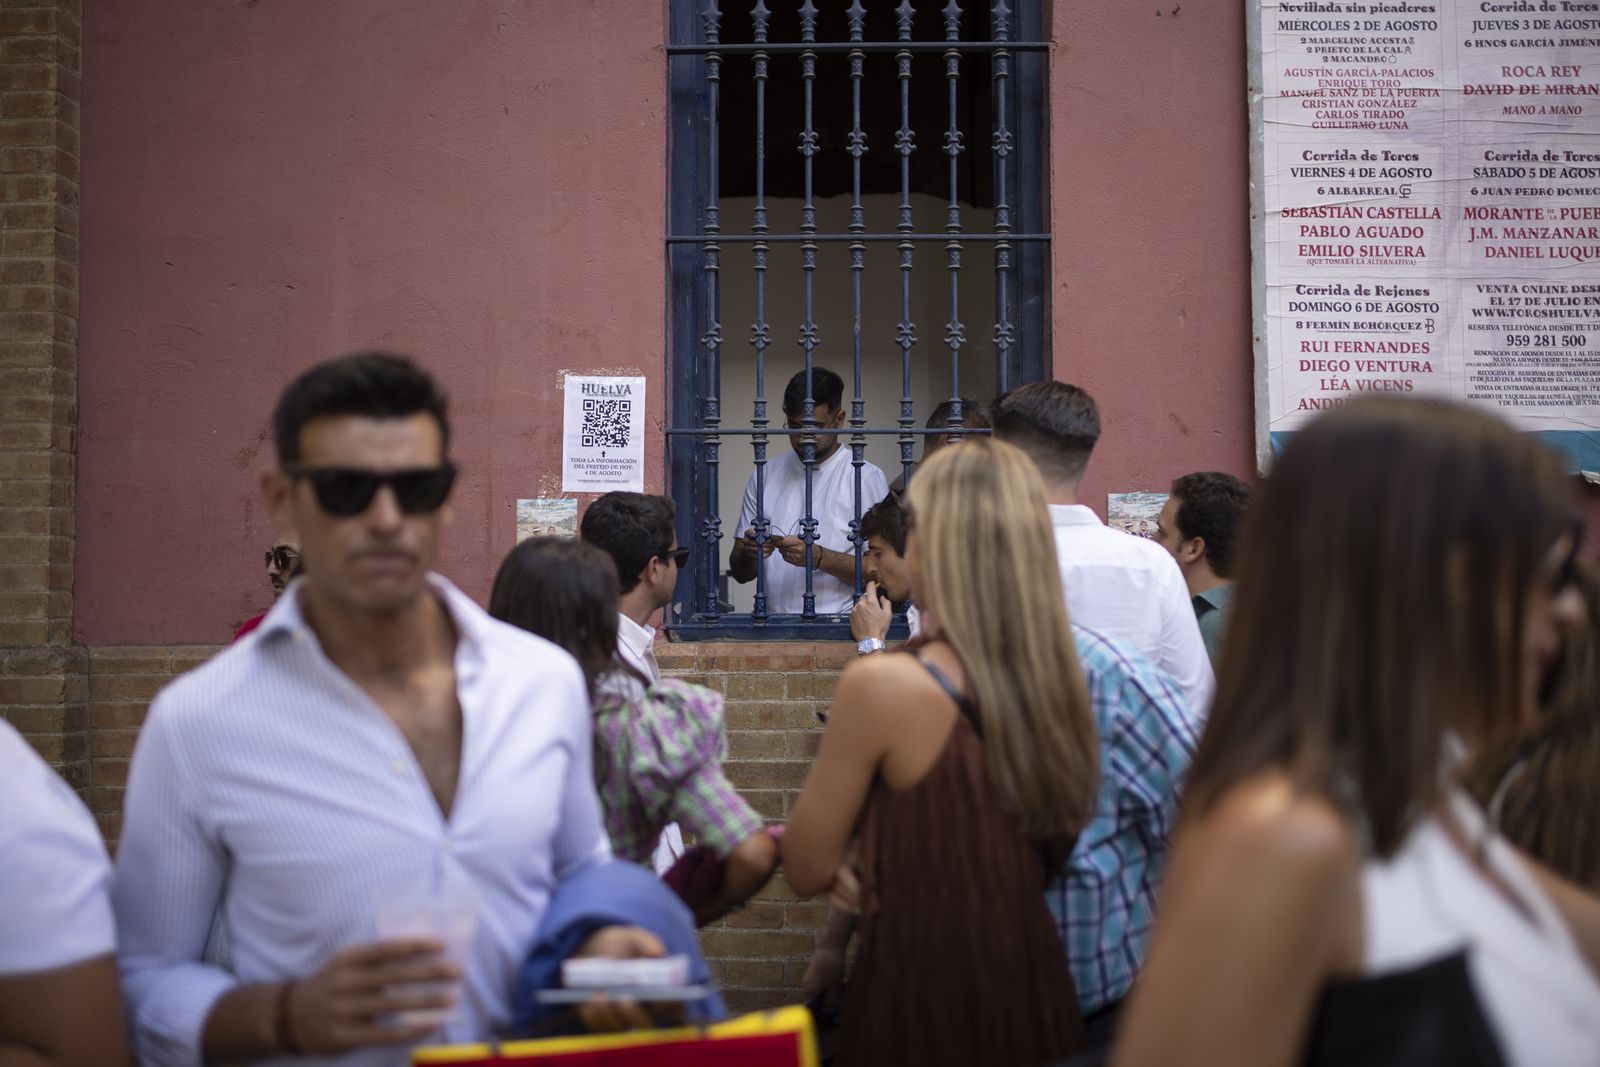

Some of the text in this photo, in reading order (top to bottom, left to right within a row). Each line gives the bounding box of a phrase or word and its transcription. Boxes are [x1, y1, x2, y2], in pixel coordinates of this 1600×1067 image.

[1279, 2, 1435, 14] Novillada sin picadores
[1480, 1, 1599, 12] Corrida de Toros
[1278, 18, 1437, 30] MIÉRCOLES 2 DE AGOSTO
[1472, 20, 1600, 33] JUEVES 3 DE AGOST
[1510, 38, 1555, 47] GARCÍA
[1284, 67, 1434, 77] AGUSTÍN GARCÍA-PALACIOS
[1502, 66, 1581, 77] ROCA REY
[1318, 80, 1367, 89] ENRIQUE
[1463, 85, 1514, 95] DAVID
[1519, 85, 1540, 95] DE
[1302, 97, 1417, 108] CRISTIAN GONZÁLEZ
[1502, 106, 1582, 115] MANO A MANO
[1303, 150, 1419, 161] Corrida de Toros
[1484, 150, 1600, 161] Corrida de Toros
[1291, 168, 1432, 178] VIERNES 4 DE AGOSTO
[1473, 166, 1525, 178] SÁBADO
[1529, 168, 1535, 178] 5
[1540, 168, 1556, 178] DE
[1328, 187, 1397, 195] ALBARREAL
[1471, 187, 1478, 195] 6
[1515, 188, 1554, 196] PEDRO
[1282, 204, 1441, 219] SEBASTIÁN CASTELLA
[1464, 208, 1544, 220] MORANTE
[1300, 225, 1424, 238] PABLO AGUADO
[1468, 227, 1600, 242] J.M. MANZANAR
[1298, 245, 1426, 257] EMILIO SILVERA
[1485, 247, 1600, 262] DANIEL LUQUE
[1296, 284, 1430, 298] Corrida de Rejones
[1477, 285, 1518, 293] VENTA
[1522, 285, 1568, 294] ONLINE
[1490, 297, 1600, 306] EL 17 DE JULIO EN
[1289, 302, 1439, 313] DOMINGO 6 DE AGOSTO
[1306, 320, 1350, 329] FERMÍN
[1353, 320, 1422, 330] BOHÓRQUEZ
[1507, 335, 1586, 347] 959 281 500
[1301, 341, 1430, 354] RUI FERNANDES
[1300, 360, 1433, 372] DIEGO VENTURA
[1320, 375, 1413, 391] LÉA VICENS
[582, 384, 632, 395] HUELVA
[1298, 394, 1354, 410] ANDRÉ
